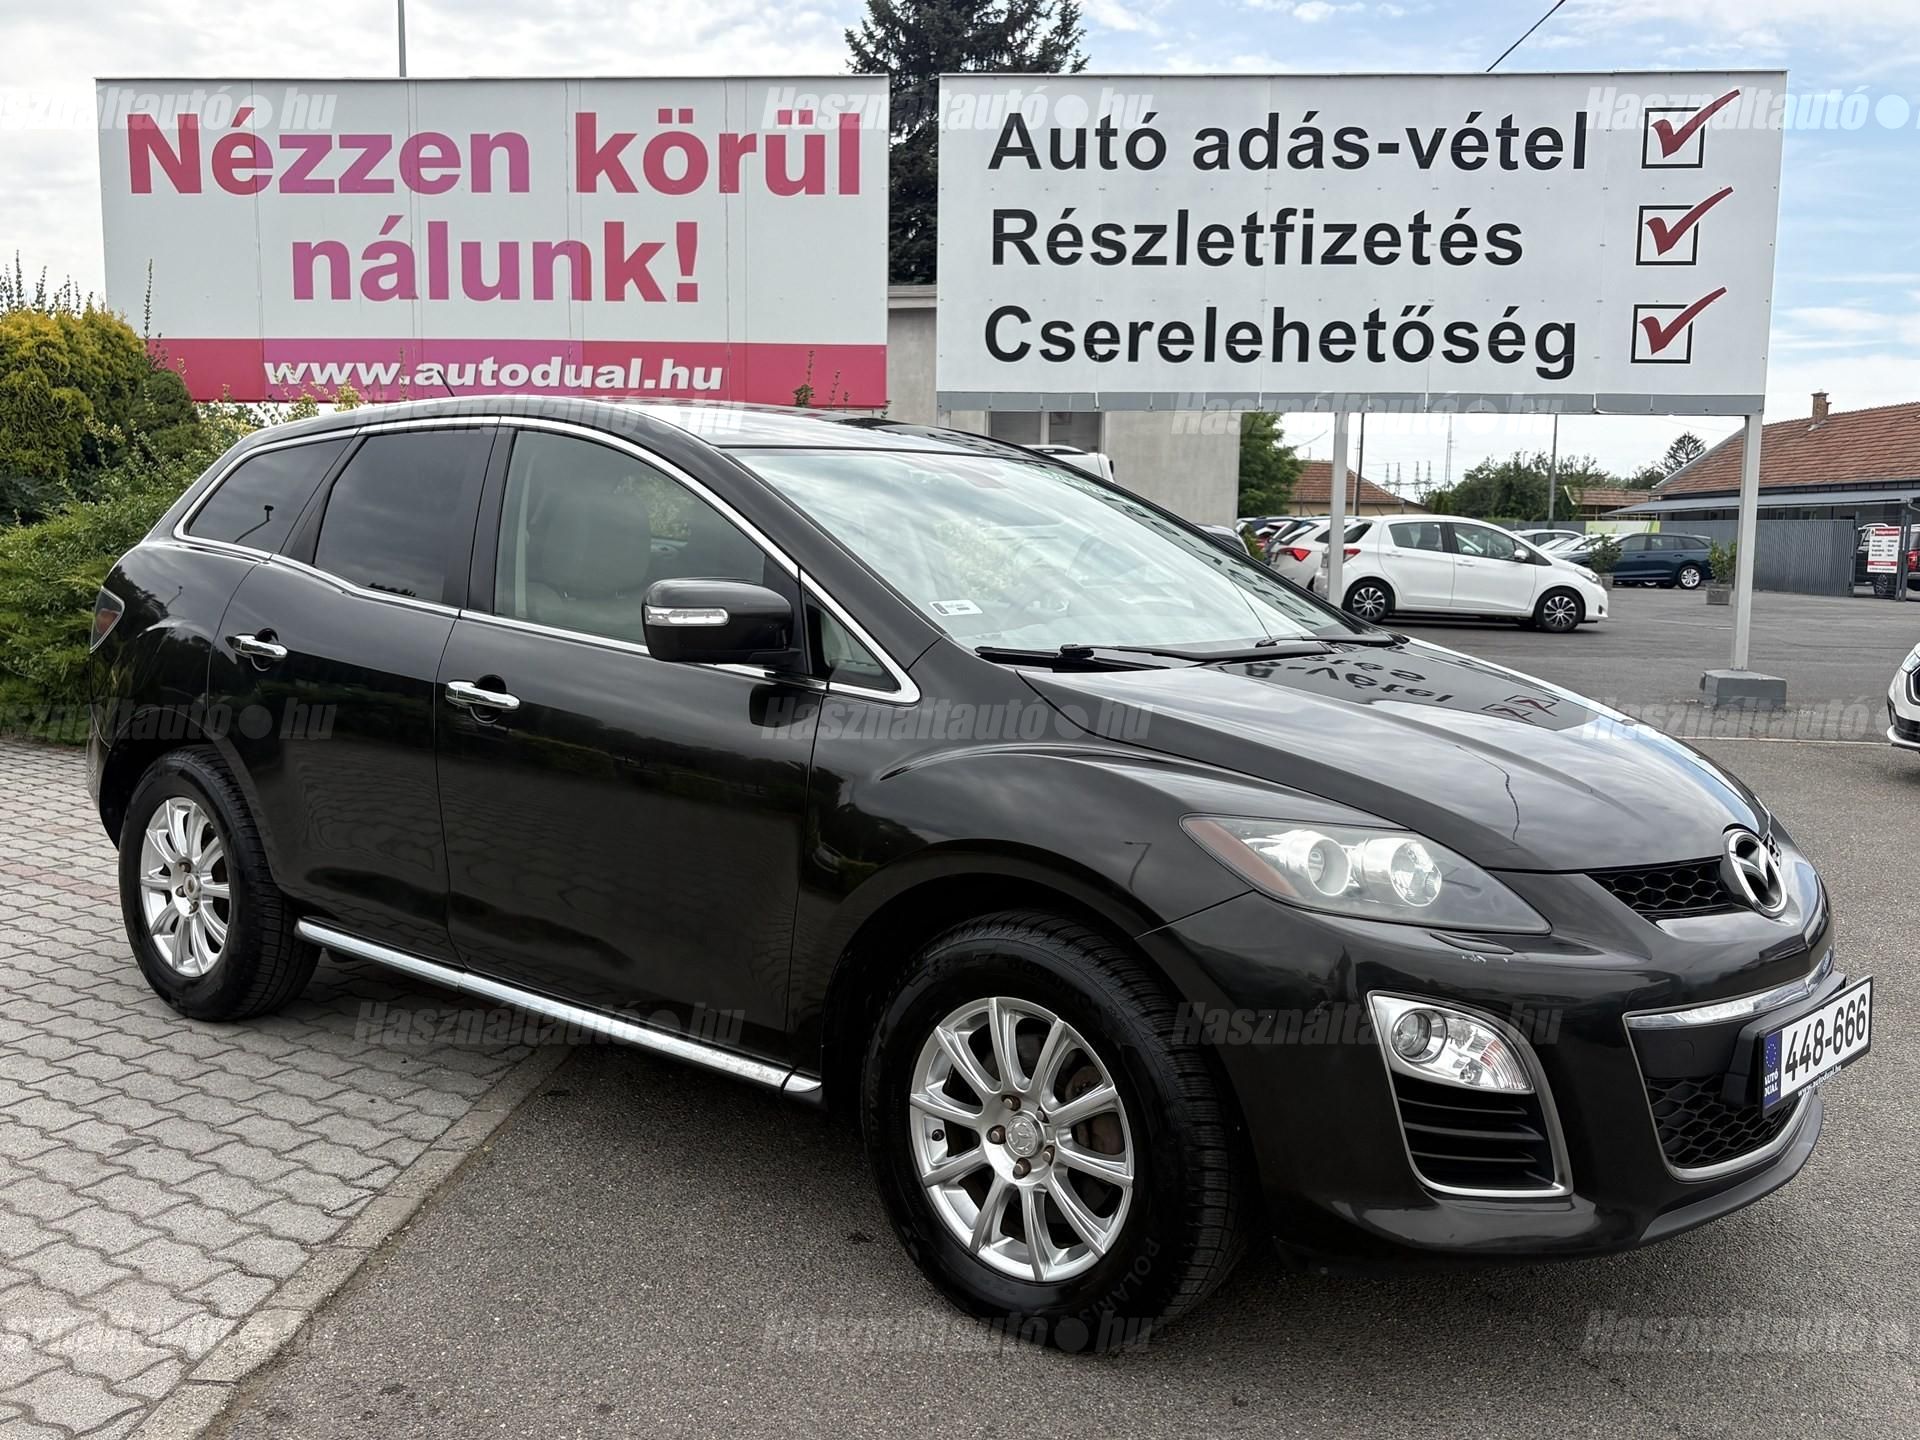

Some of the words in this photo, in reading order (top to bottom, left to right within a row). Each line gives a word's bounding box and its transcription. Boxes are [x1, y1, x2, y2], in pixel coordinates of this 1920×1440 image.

[128, 108, 529, 195] Nézzen
[576, 109, 860, 196] körül
[988, 112, 1167, 171] Autó
[1193, 111, 1588, 171] adás-vétel
[293, 215, 698, 302] nálunk!
[992, 207, 1523, 267] Részletfizetés
[264, 356, 723, 391] www.autodual.hu
[985, 304, 1576, 379] Cserelehetőség
[1785, 993, 1867, 1082] 448-666
